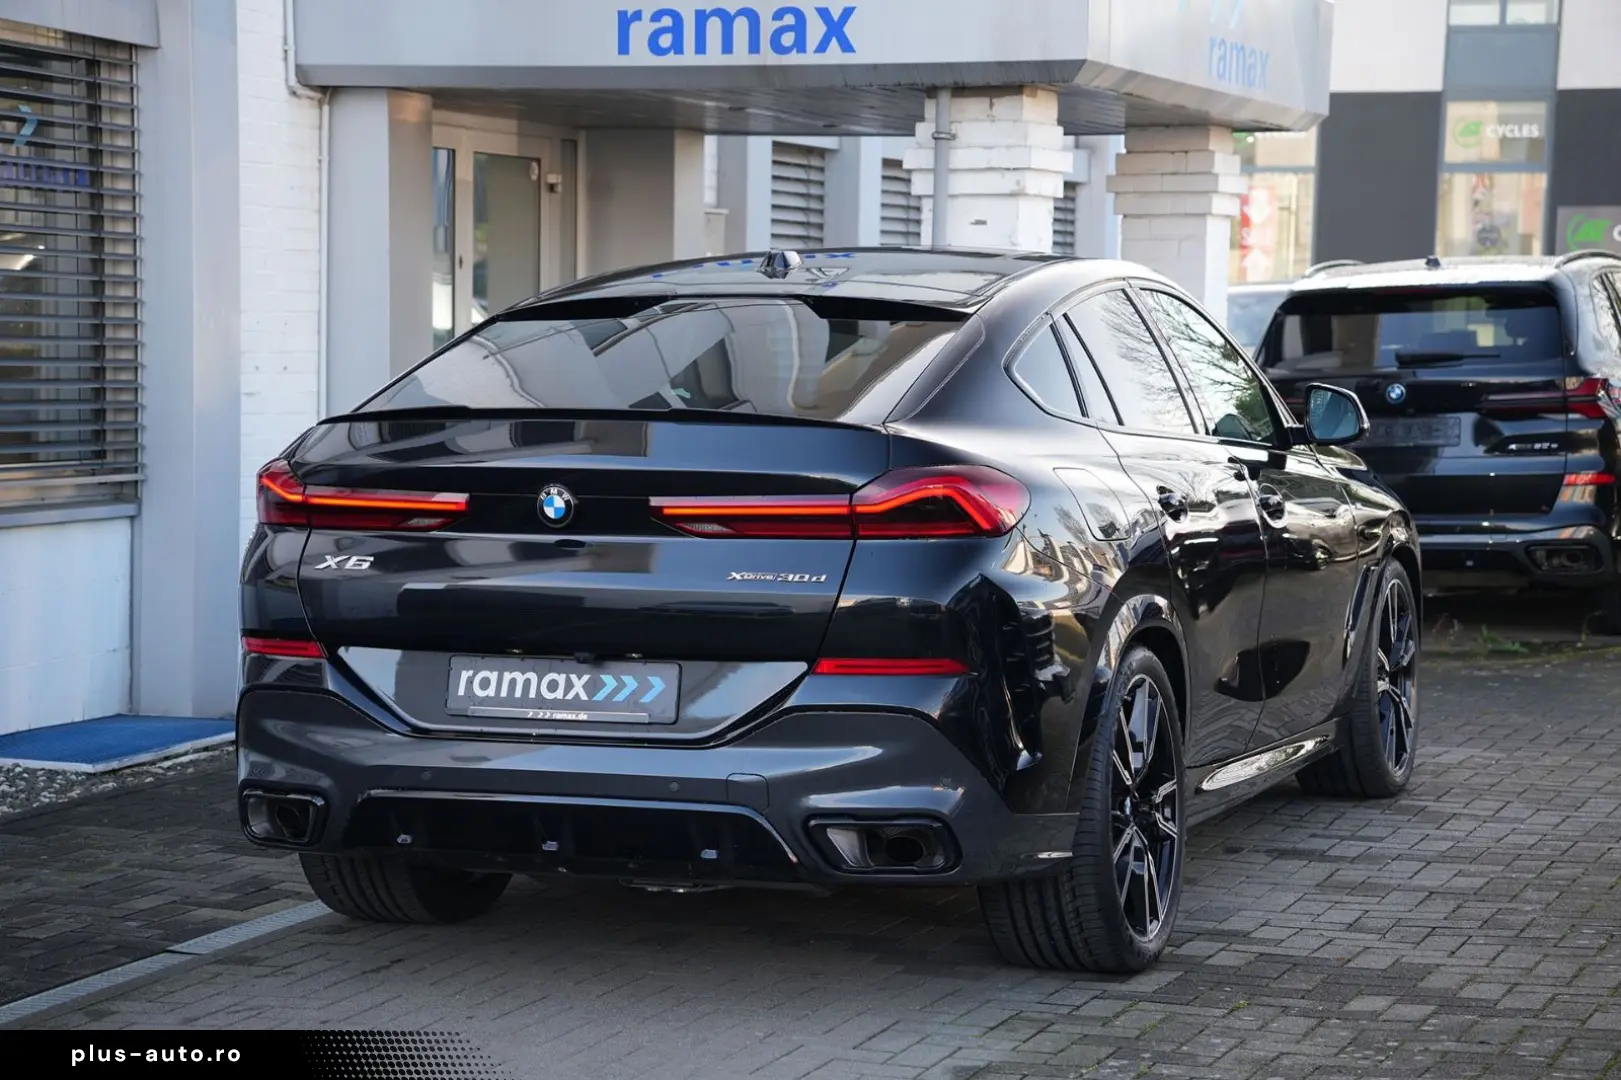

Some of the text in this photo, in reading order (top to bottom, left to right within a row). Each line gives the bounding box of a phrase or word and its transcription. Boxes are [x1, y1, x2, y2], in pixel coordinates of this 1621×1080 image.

[617, 6, 857, 56] ramax
[1208, 36, 1270, 89] ramax
[1486, 123, 1540, 138] CYCLES
[314, 555, 375, 570] X6
[457, 669, 592, 701] ramax
[553, 712, 588, 720] ramax.de
